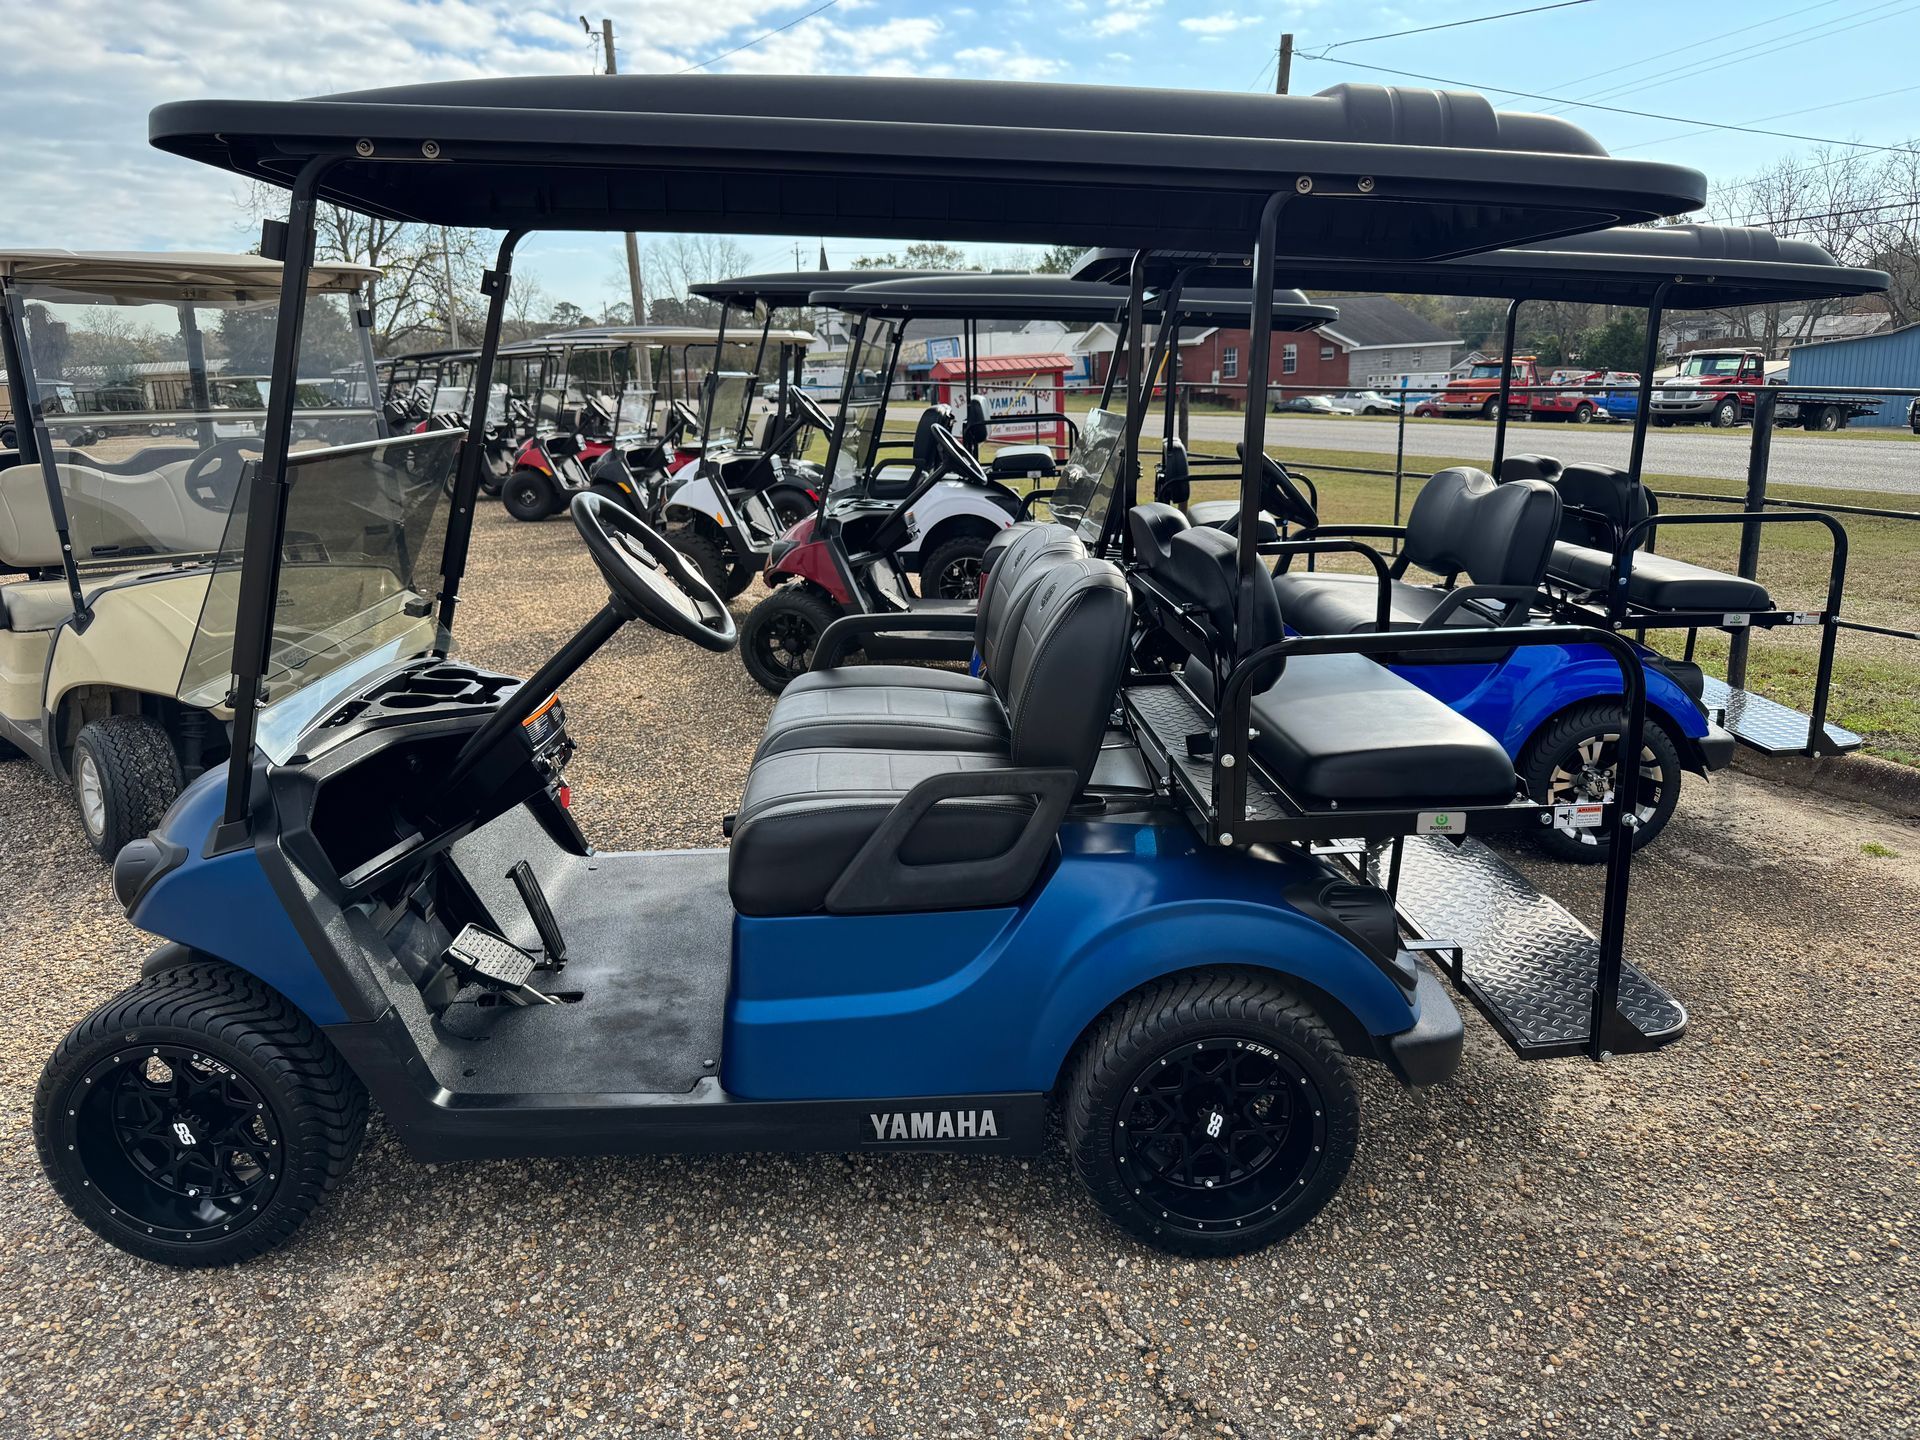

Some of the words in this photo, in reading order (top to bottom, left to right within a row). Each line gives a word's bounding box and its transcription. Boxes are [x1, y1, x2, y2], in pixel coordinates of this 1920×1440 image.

[989, 396, 1027, 409] YAMAHA
[1246, 1043, 1273, 1056] GTW
[202, 1058, 230, 1074] GTW
[870, 1109, 998, 1140] YAMAHA
